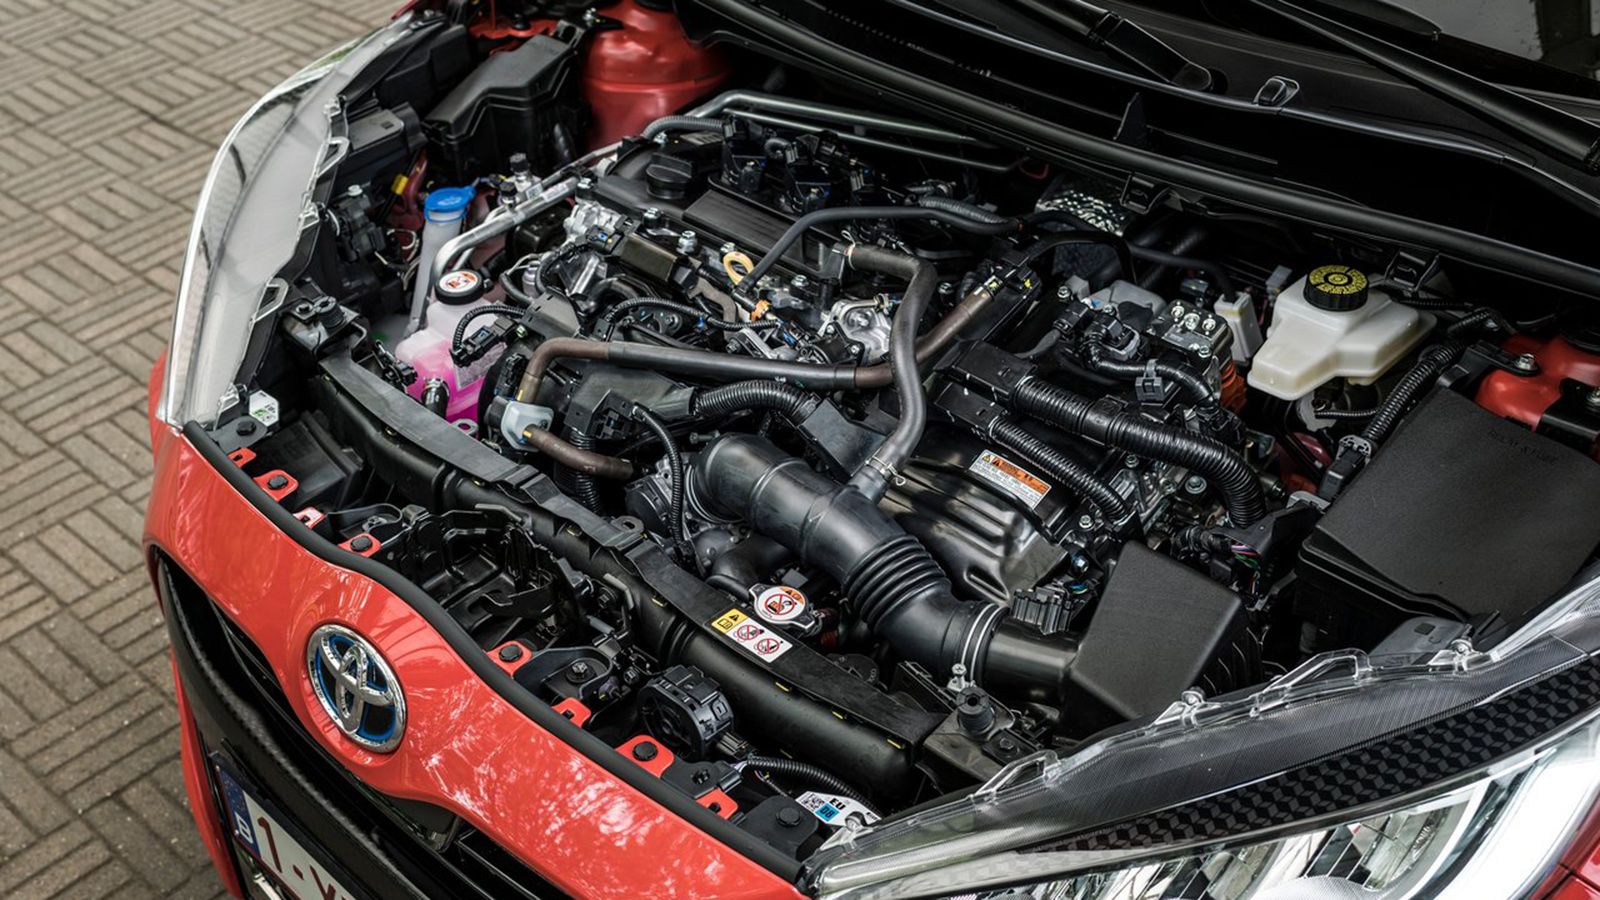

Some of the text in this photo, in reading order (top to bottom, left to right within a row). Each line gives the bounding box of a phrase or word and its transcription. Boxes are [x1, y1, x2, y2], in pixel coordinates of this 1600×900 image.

[829, 798, 846, 810] EU
[234, 811, 254, 844] B
[257, 816, 347, 900] 1-Y
